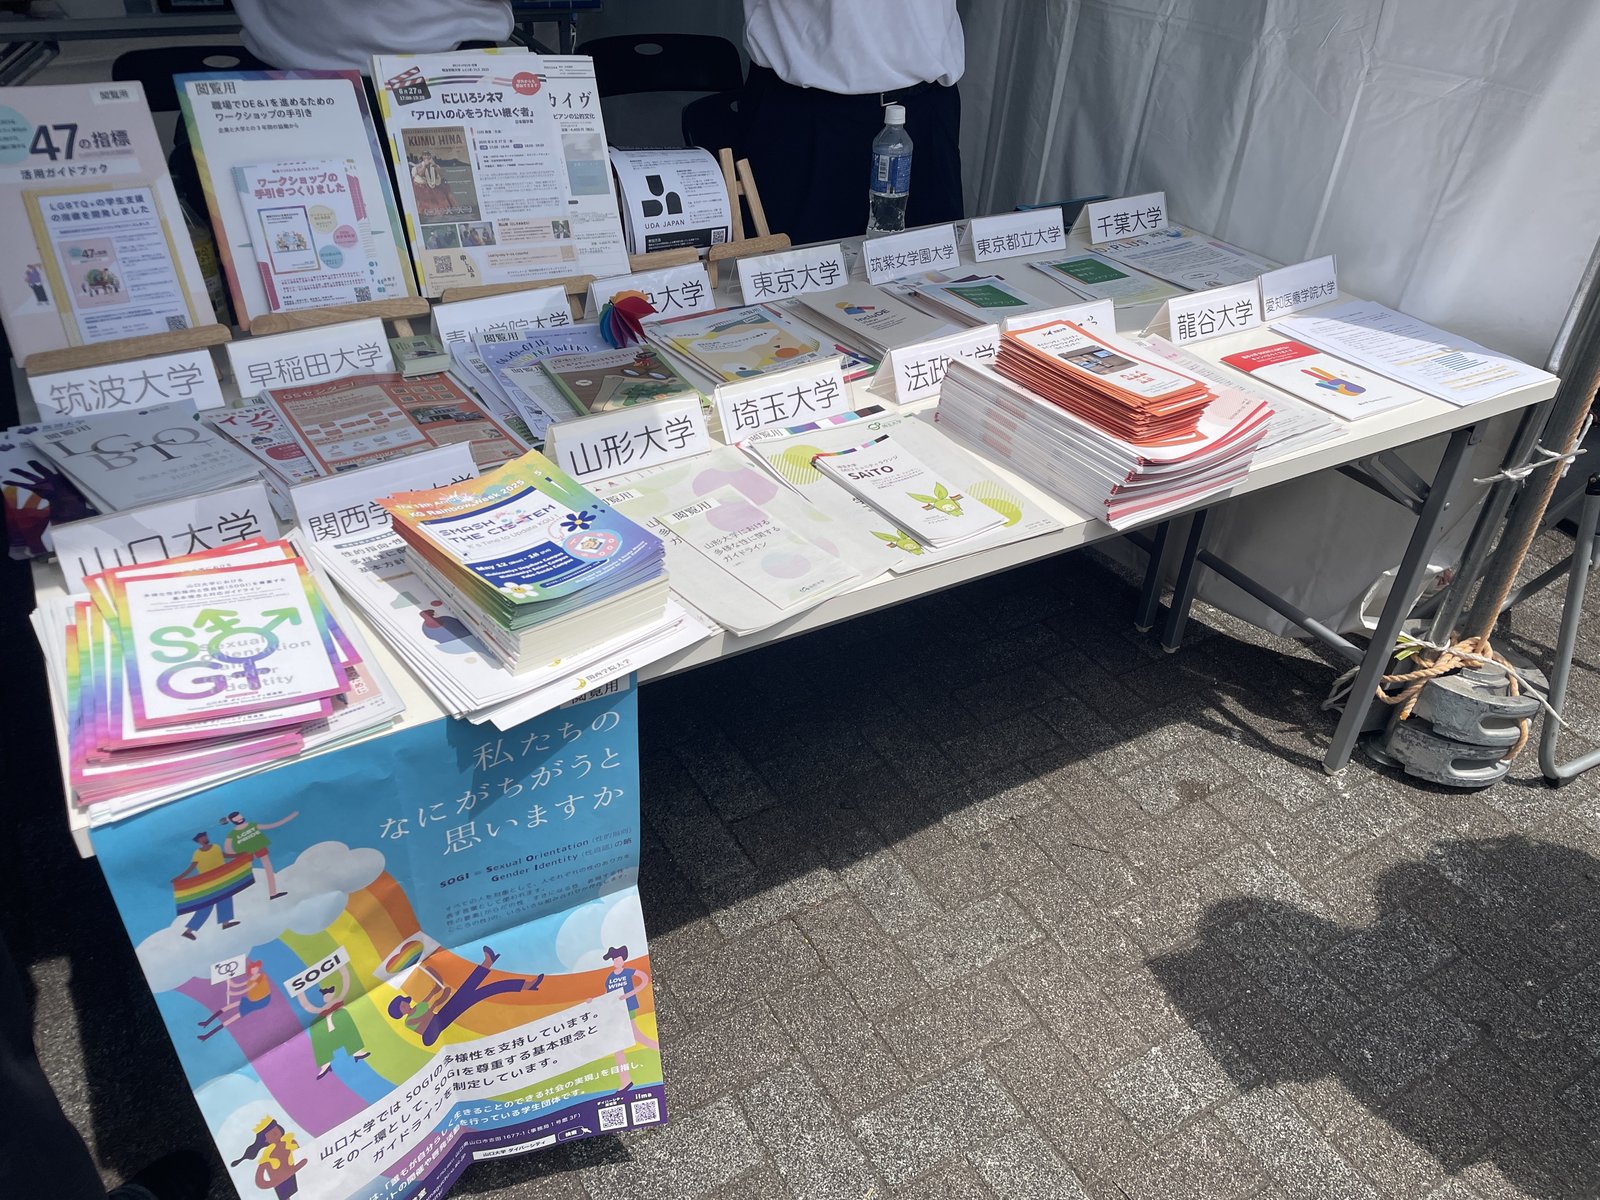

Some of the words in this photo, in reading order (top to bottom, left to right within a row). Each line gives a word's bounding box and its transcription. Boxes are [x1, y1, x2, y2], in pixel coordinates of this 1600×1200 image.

[195, 81, 237, 96] 閲覧用
[441, 92, 504, 105] にじいろシネマ
[215, 109, 313, 122] ワークショップの手引き
[408, 135, 436, 147] KUMU
[439, 134, 462, 145] HINA
[21, 164, 108, 180] 活用ガイドブック
[257, 172, 338, 188] ワークショップの
[254, 183, 346, 200] 手引きつくりました
[645, 221, 660, 230] UDA
[663, 219, 685, 228] JAPAN
[1097, 207, 1162, 238] 千葉大学
[976, 225, 1061, 255] 東京都立大学
[869, 244, 954, 273] 筑紫女学園大学
[750, 260, 840, 298] 東京大学
[1265, 280, 1336, 314] 愛知医療学院大学
[1177, 299, 1253, 341] 龍谷大学
[483, 331, 519, 343] 閲覧用
[247, 341, 384, 388] 早稲田大学
[49, 362, 204, 416] 筑波大学
[732, 376, 840, 431] 埼玉大学
[570, 414, 696, 477] 山形大学
[500, 479, 526, 496] 2025
[672, 500, 712, 522] 閲覧用
[439, 519, 496, 537] SMASH
[448, 531, 485, 544] THE
[704, 518, 771, 550] 山形大学における
[714, 527, 781, 556] 多様な性に関する
[723, 541, 768, 563] ガイドライン
[475, 564, 496, 572] May
[472, 711, 621, 772] 私たちの
[380, 747, 622, 840] なにがちがうと
[443, 786, 625, 856] 思いますか
[439, 872, 470, 889] SOGI
[486, 857, 523, 873] Sexual
[525, 839, 590, 862] Orientation
[491, 867, 530, 883] Gender
[534, 853, 578, 872] Identity
[291, 954, 341, 991] SOGI
[608, 981, 628, 990] WINS
[609, 975, 627, 985] LOVE
[372, 1058, 559, 1163] ガイドラインを制定しています。
[564, 1129, 578, 1138] 検索
